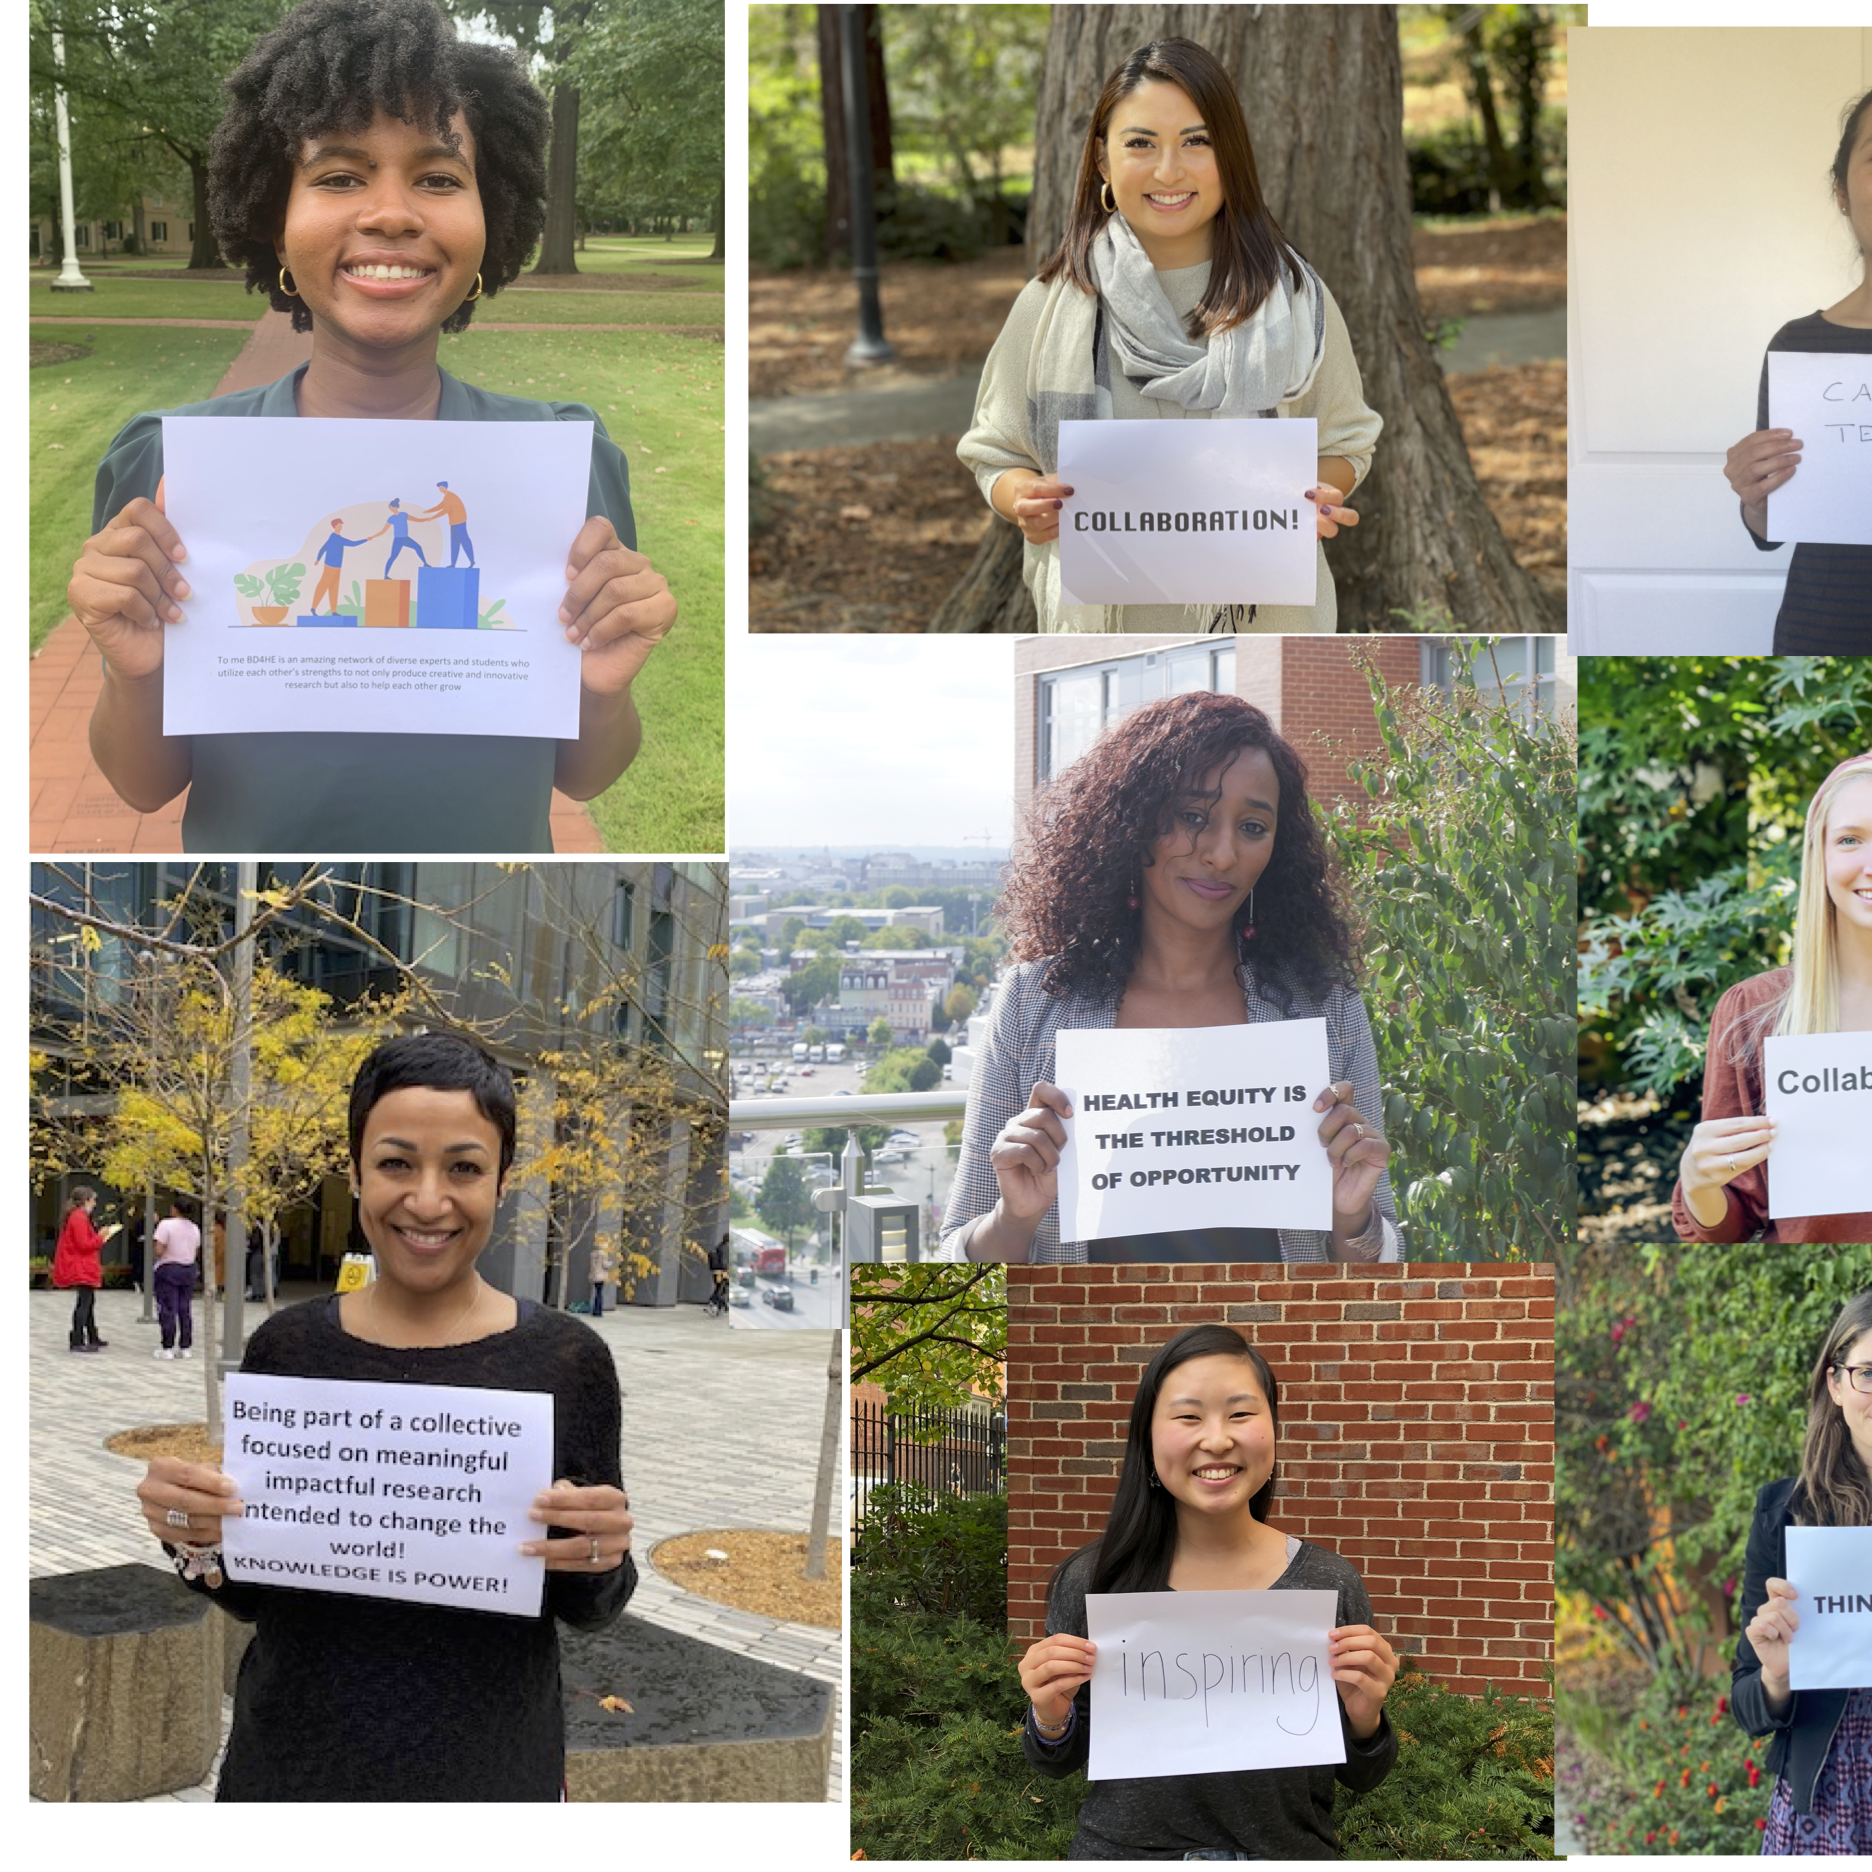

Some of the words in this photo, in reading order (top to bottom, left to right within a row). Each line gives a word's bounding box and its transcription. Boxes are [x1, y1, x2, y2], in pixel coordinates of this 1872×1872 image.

[1074, 509, 1299, 532] COLLABORATION!
[218, 656, 228, 664] To
[247, 656, 276, 664] BD4HE
[278, 656, 285, 664] is
[300, 656, 336, 665] amazing
[338, 656, 373, 664] network
[376, 656, 385, 664] of
[387, 656, 417, 664] diverse
[419, 657, 451, 666] experts
[471, 659, 508, 667] students
[511, 660, 529, 668] who
[218, 669, 244, 677] utilize
[246, 668, 266, 676] each
[302, 668, 341, 678] strengths
[372, 669, 390, 678] only
[392, 669, 427, 678] produce
[466, 671, 481, 679] and
[484, 672, 529, 680] innovative
[285, 681, 322, 689] research
[324, 681, 338, 689] but
[341, 681, 358, 689] also
[371, 682, 390, 690] help
[392, 682, 412, 690] each
[414, 682, 437, 690] other
[440, 684, 461, 692] grow
[1083, 1091, 1178, 1112] HEALTH
[1186, 1087, 1277, 1107] EQUITY
[1284, 1085, 1306, 1102] IS
[1094, 1132, 1144, 1150] THE
[1151, 1126, 1295, 1147] THRESHOLD
[1092, 1172, 1122, 1190] OF
[1130, 1164, 1301, 1187] OPPORTUNITY
[232, 1400, 296, 1428] Being
[303, 1409, 353, 1429] part
[360, 1409, 384, 1429] of
[390, 1415, 402, 1431] a
[410, 1412, 522, 1437] collective
[241, 1435, 331, 1460] focused
[339, 1448, 368, 1462] on
[376, 1448, 509, 1473] meaningful
[265, 1472, 375, 1496] impactful
[382, 1481, 482, 1503] research
[240, 1500, 341, 1526] ntended
[349, 1509, 372, 1528] to
[379, 1512, 462, 1536] change
[469, 1516, 507, 1535] the
[329, 1540, 406, 1559] world!
[233, 1556, 382, 1583] KNOWLEDGE
[388, 1569, 408, 1584] IS
[414, 1570, 509, 1594] POWER!
[1121, 1638, 1320, 1736] inspiring
